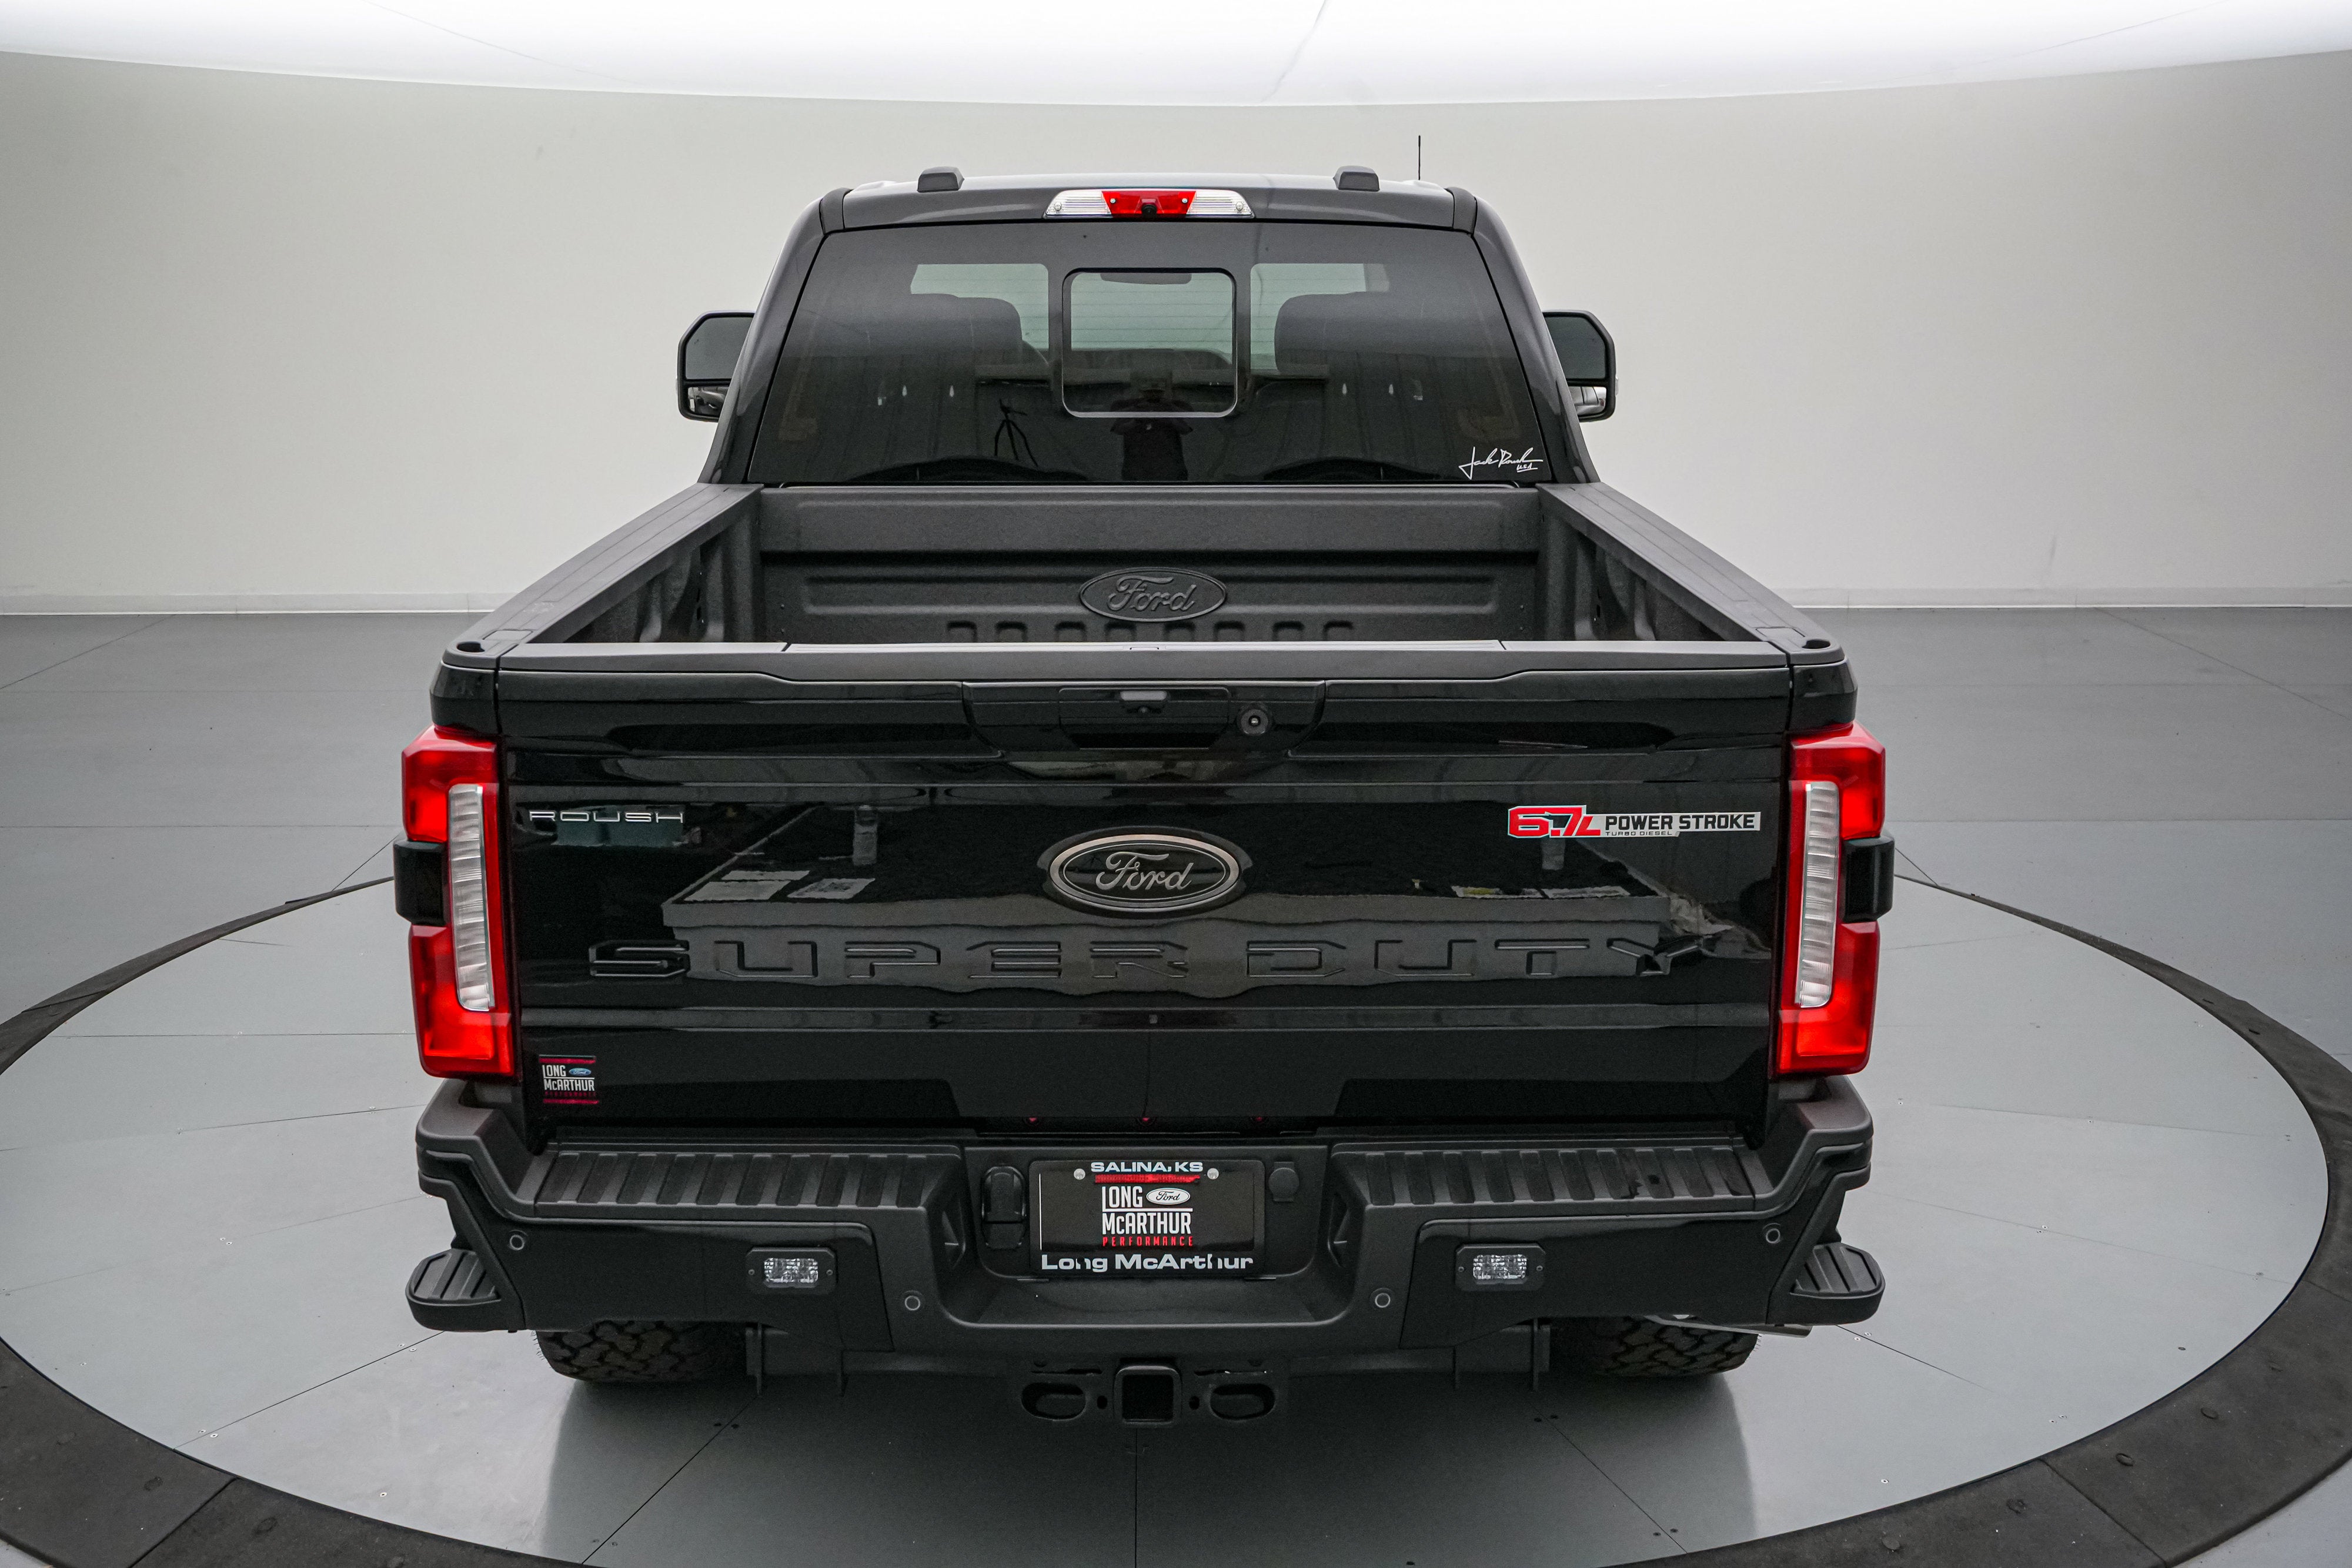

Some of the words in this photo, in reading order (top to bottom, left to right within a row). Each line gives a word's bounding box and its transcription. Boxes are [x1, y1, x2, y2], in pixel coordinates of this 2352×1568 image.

[1107, 575, 1197, 611] Ford
[529, 811, 683, 823] ROUSH
[1508, 805, 1601, 837] 6.7L
[1605, 815, 1673, 830] POWER
[1679, 814, 1755, 830] STROKE
[1095, 851, 1194, 891] Ford
[589, 940, 1187, 979] SUPER
[1246, 938, 1702, 978] DUTY
[542, 1065, 567, 1077] LONG
[1091, 1161, 1172, 1173] SALINA,
[1175, 1161, 1204, 1172] KS
[1102, 1186, 1143, 1209] LONG
[1155, 1191, 1181, 1201] Ford
[1102, 1236, 1193, 1246] PERFORMANCE
[1041, 1254, 1108, 1273] Long
[1115, 1253, 1254, 1270] McArthur
